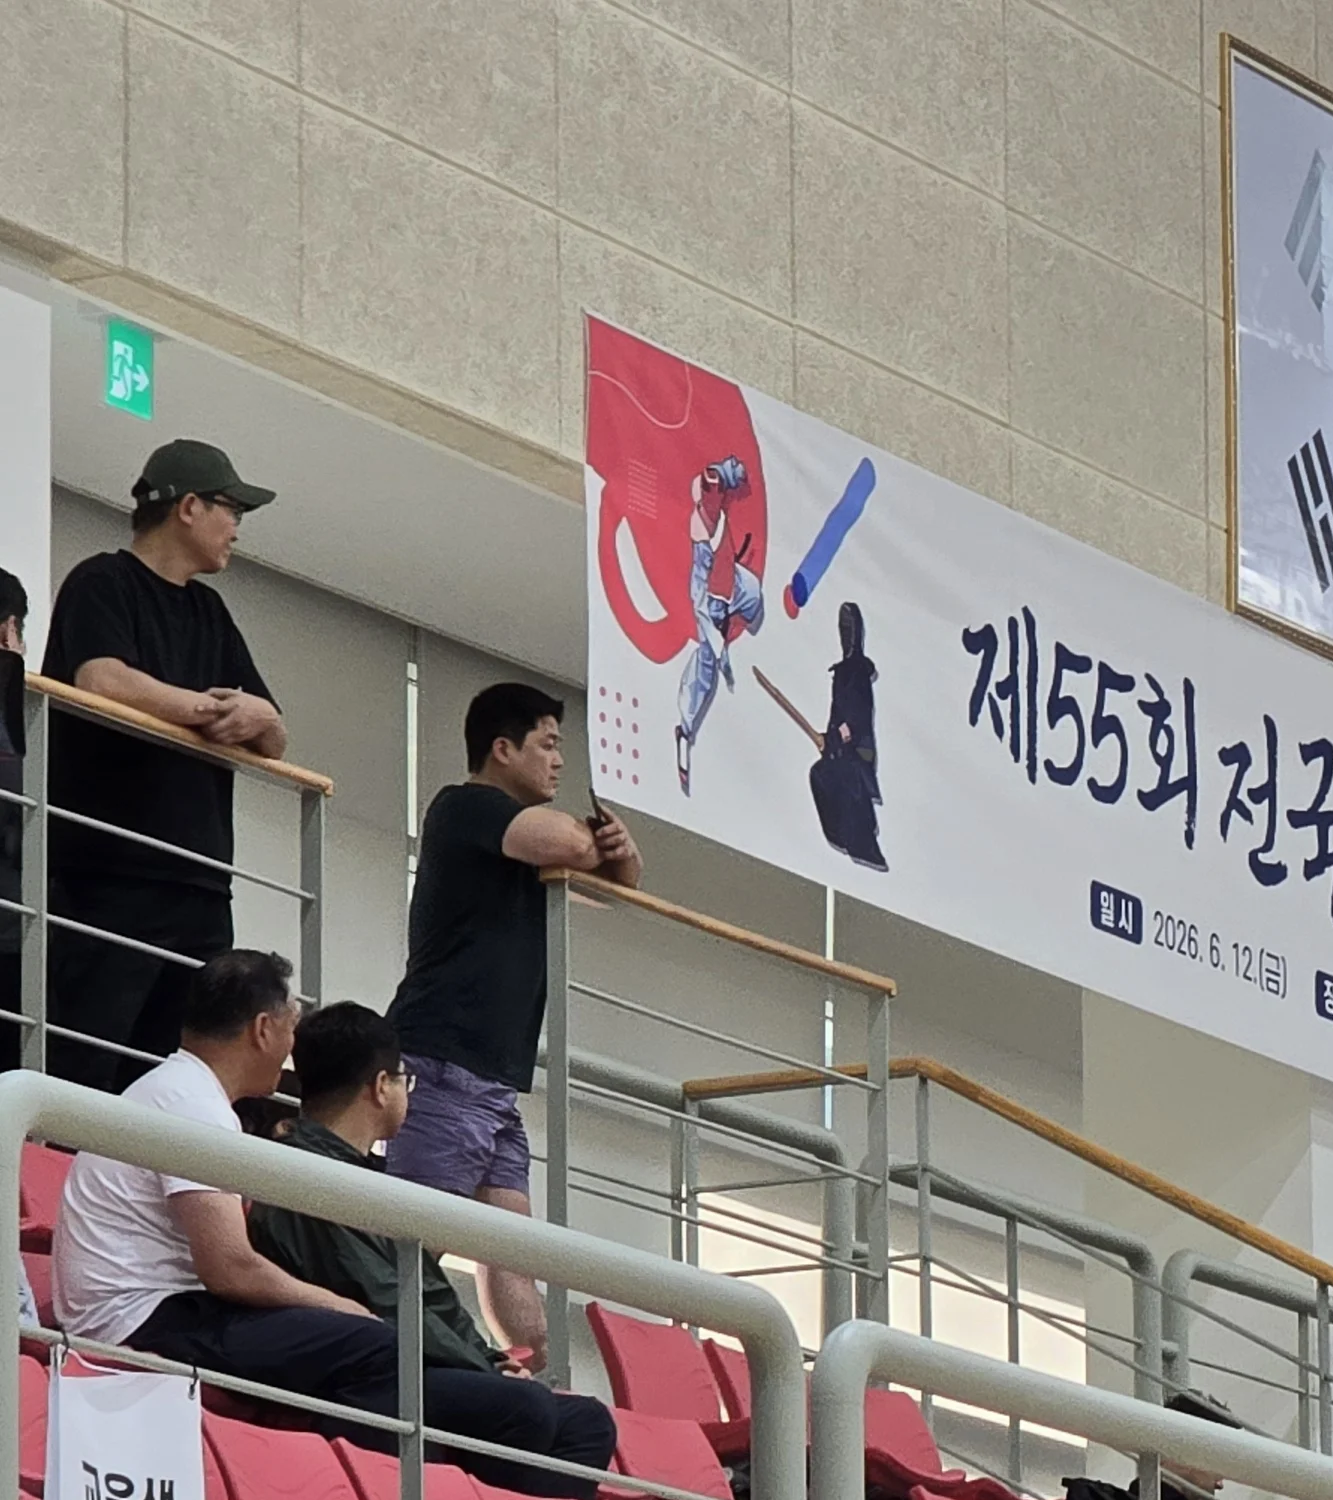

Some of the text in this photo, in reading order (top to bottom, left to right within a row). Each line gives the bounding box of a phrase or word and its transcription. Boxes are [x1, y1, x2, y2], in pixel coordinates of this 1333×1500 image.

[962, 605, 1198, 850] 제55회
[1100, 890, 1287, 999] 일시 2026. 6. 12.(금)
